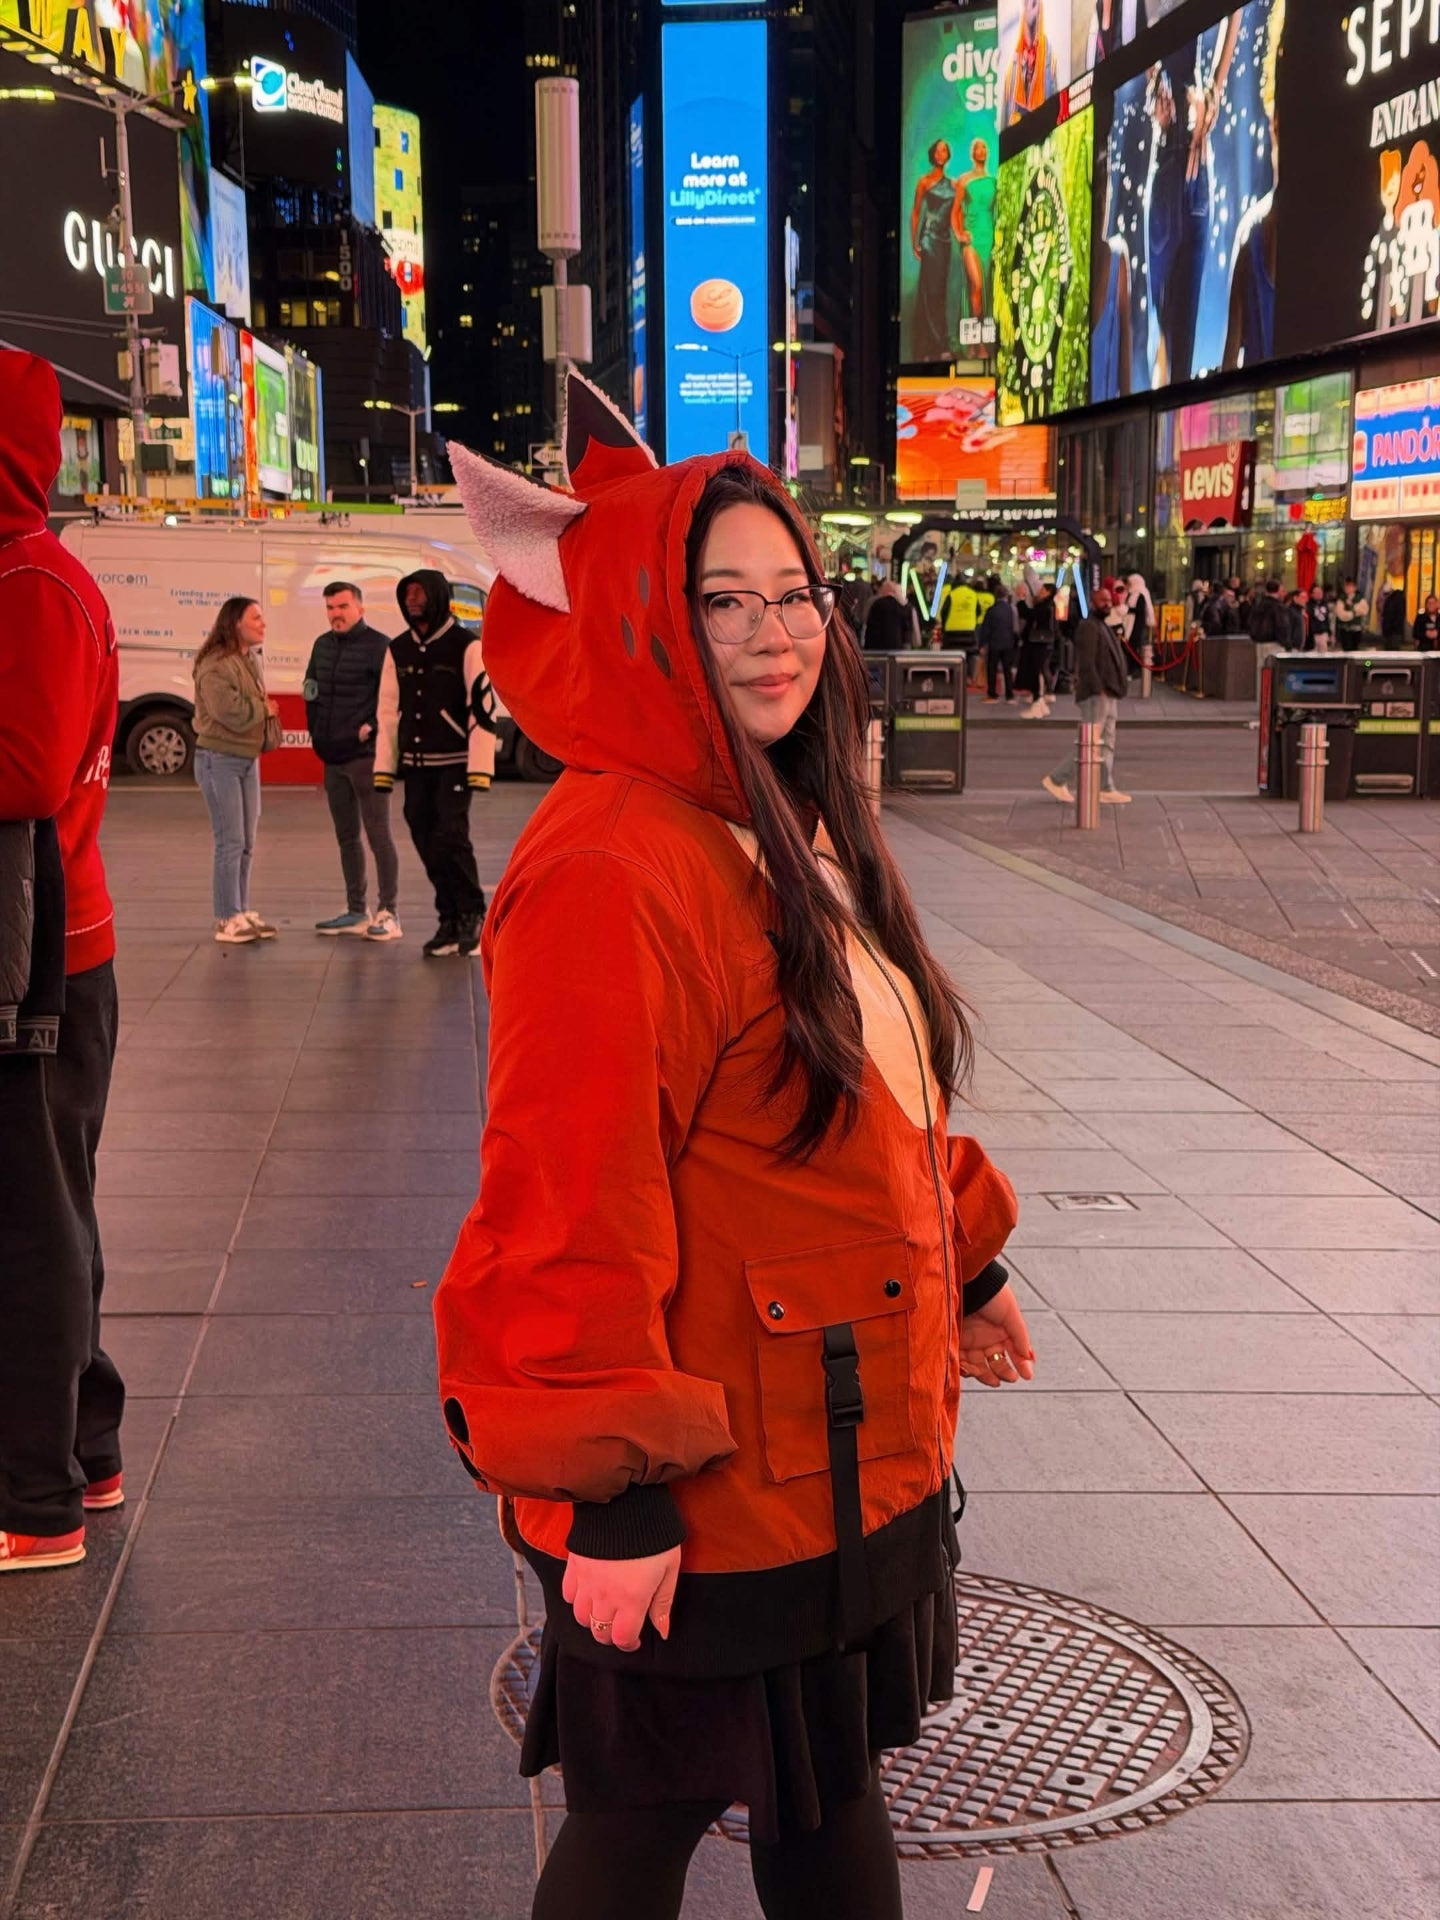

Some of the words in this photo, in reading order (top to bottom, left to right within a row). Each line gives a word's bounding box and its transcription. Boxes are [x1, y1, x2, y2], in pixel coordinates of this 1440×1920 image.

[691, 152, 739, 169] Learn
[683, 173, 726, 188] more
[728, 171, 748, 187] at
[340, 228, 352, 290] 1500
